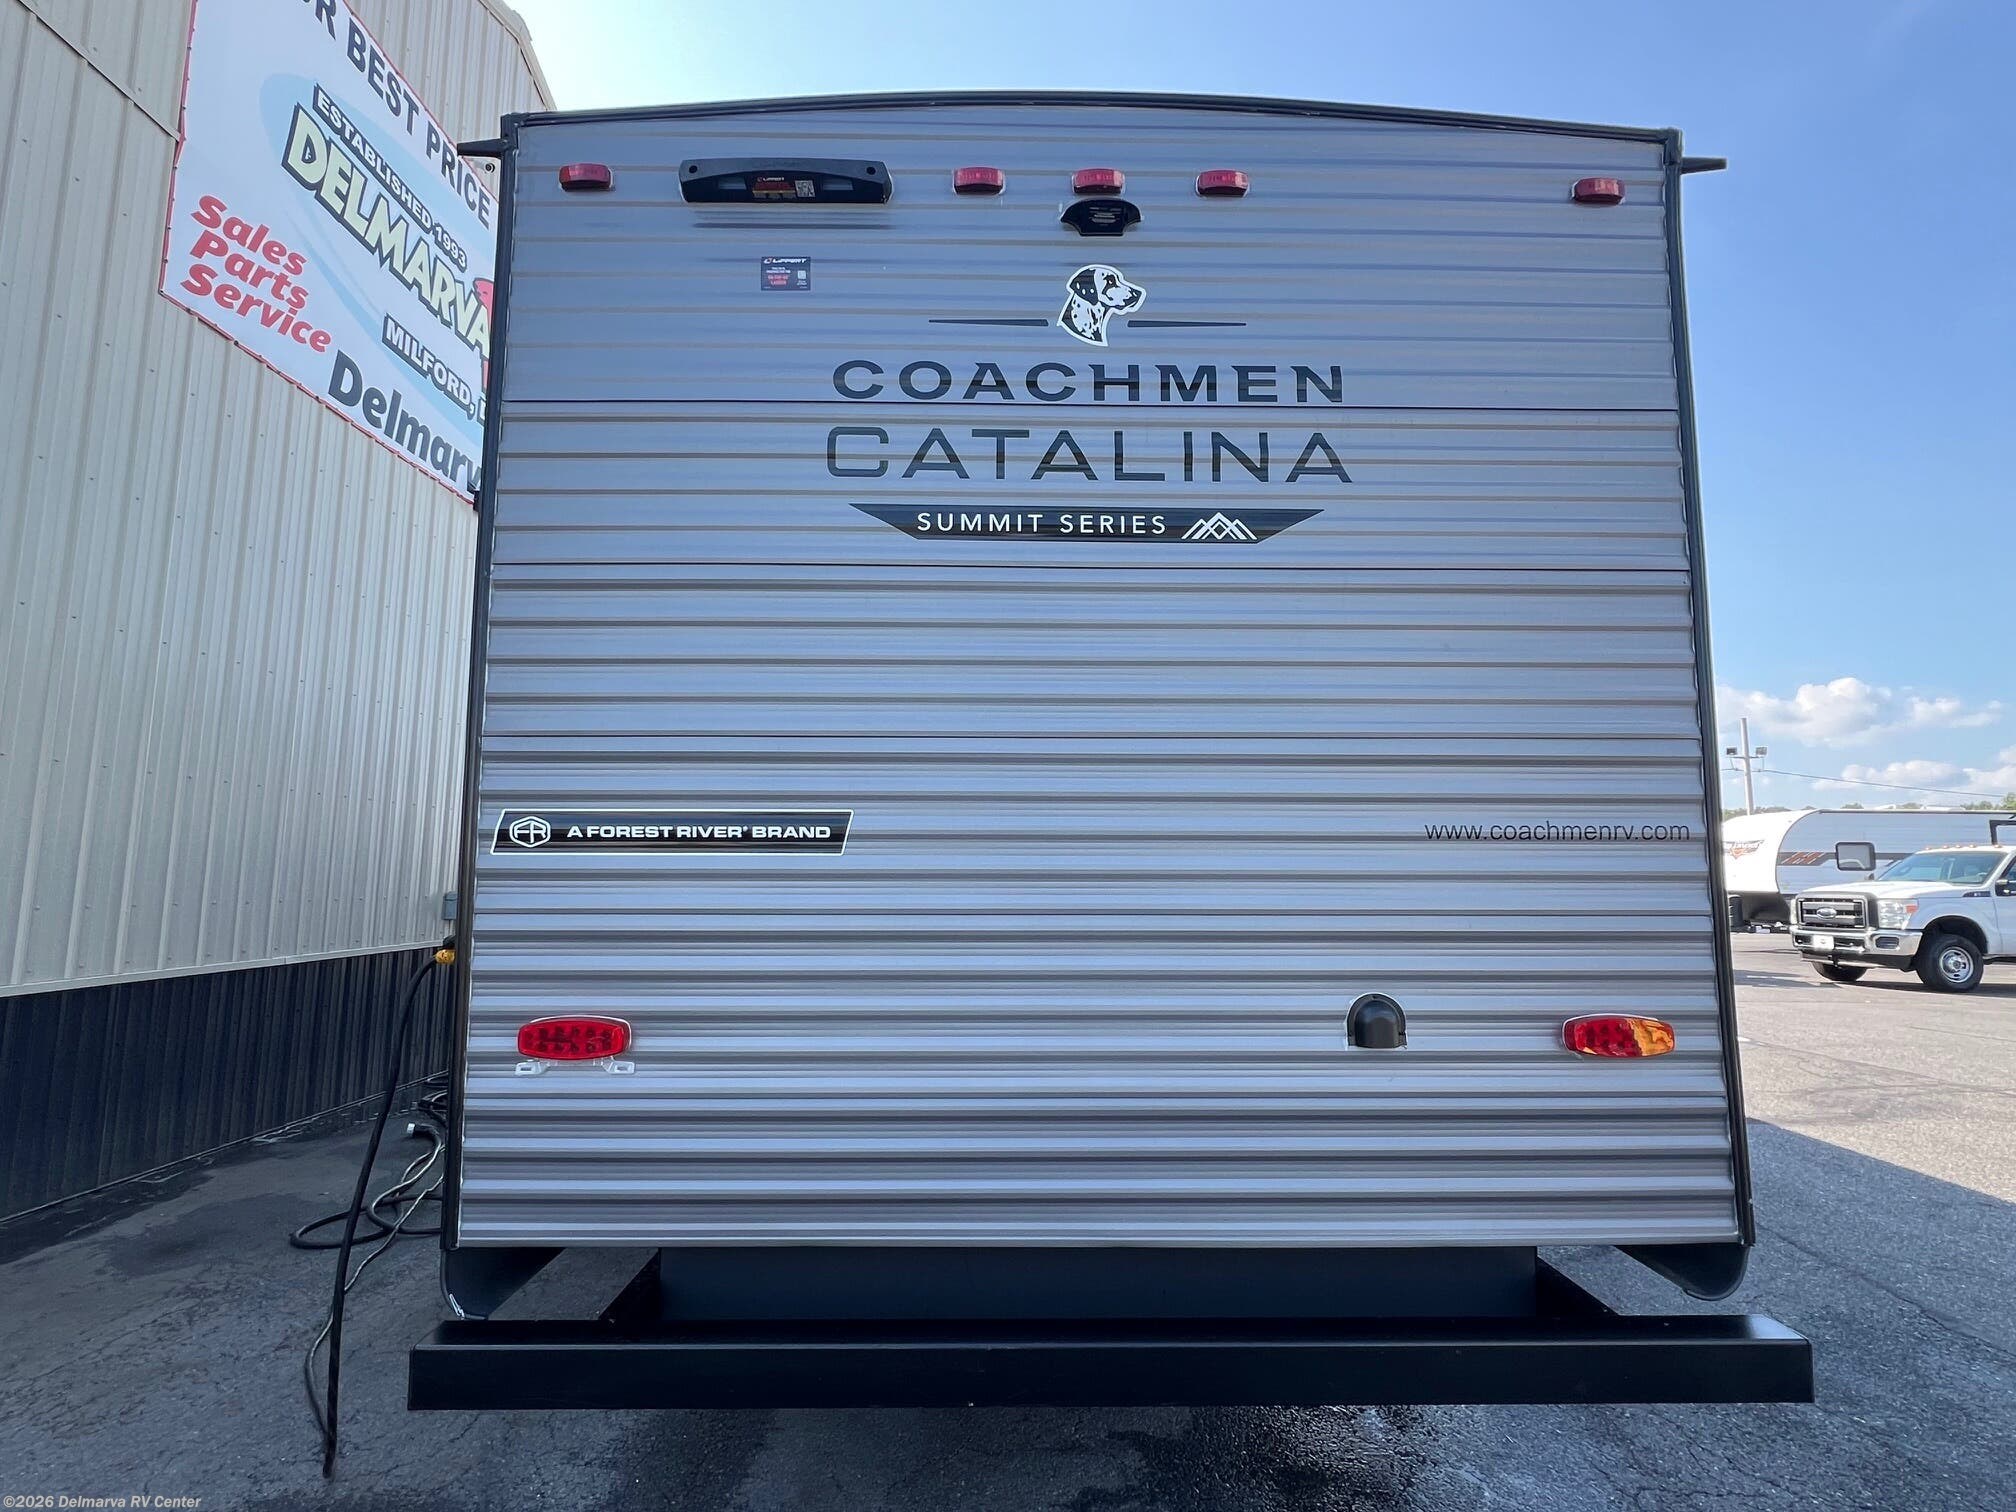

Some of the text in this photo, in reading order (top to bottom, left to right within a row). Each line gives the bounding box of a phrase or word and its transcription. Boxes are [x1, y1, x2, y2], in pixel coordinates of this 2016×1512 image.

[347, 17, 420, 136] BEST
[427, 120, 490, 231] PRICE
[317, 89, 467, 270] ESTABLISHED 1993
[190, 230, 309, 309] Parts
[191, 195, 307, 275] Sales
[283, 104, 490, 360] DELMARVA
[181, 264, 331, 352] Service
[387, 319, 475, 415] MILFORD,
[832, 360, 1343, 403] COACHMEN
[826, 426, 1353, 484] CATALINA
[916, 511, 1167, 535] SUMMIT SERIES
[567, 825, 587, 839] A
[587, 825, 673, 839] FOREST
[752, 827, 830, 839] BRAND
[1425, 820, 1690, 841] www.coachmenrv.com
